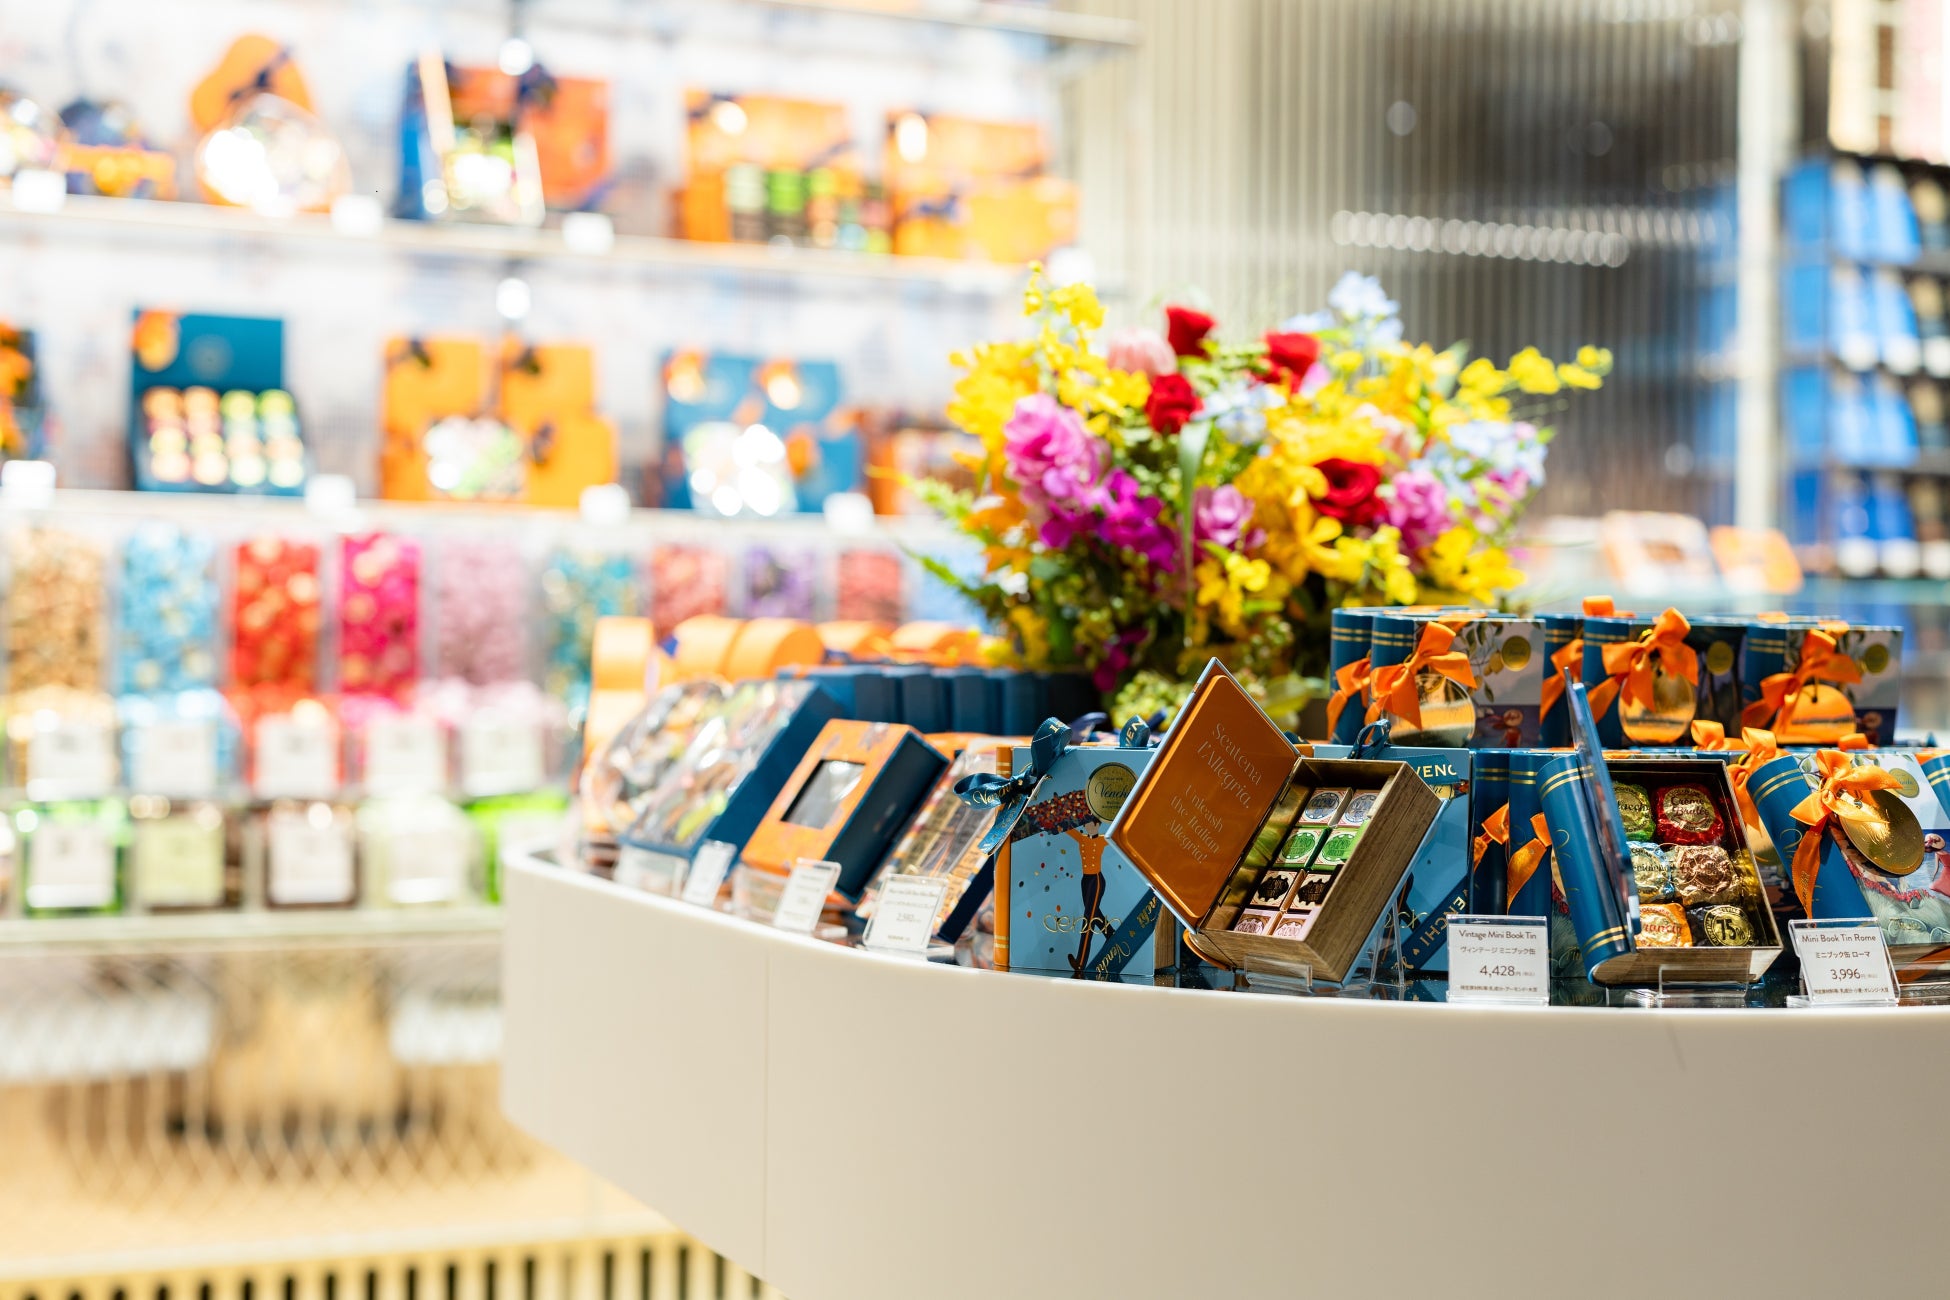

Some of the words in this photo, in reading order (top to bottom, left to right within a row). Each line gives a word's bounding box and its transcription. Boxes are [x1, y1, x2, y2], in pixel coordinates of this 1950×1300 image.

[1459, 930, 1486, 940] Vintage
[1506, 931, 1523, 939] Book
[1802, 935, 1818, 943] Mini
[1820, 934, 1839, 942] Book
